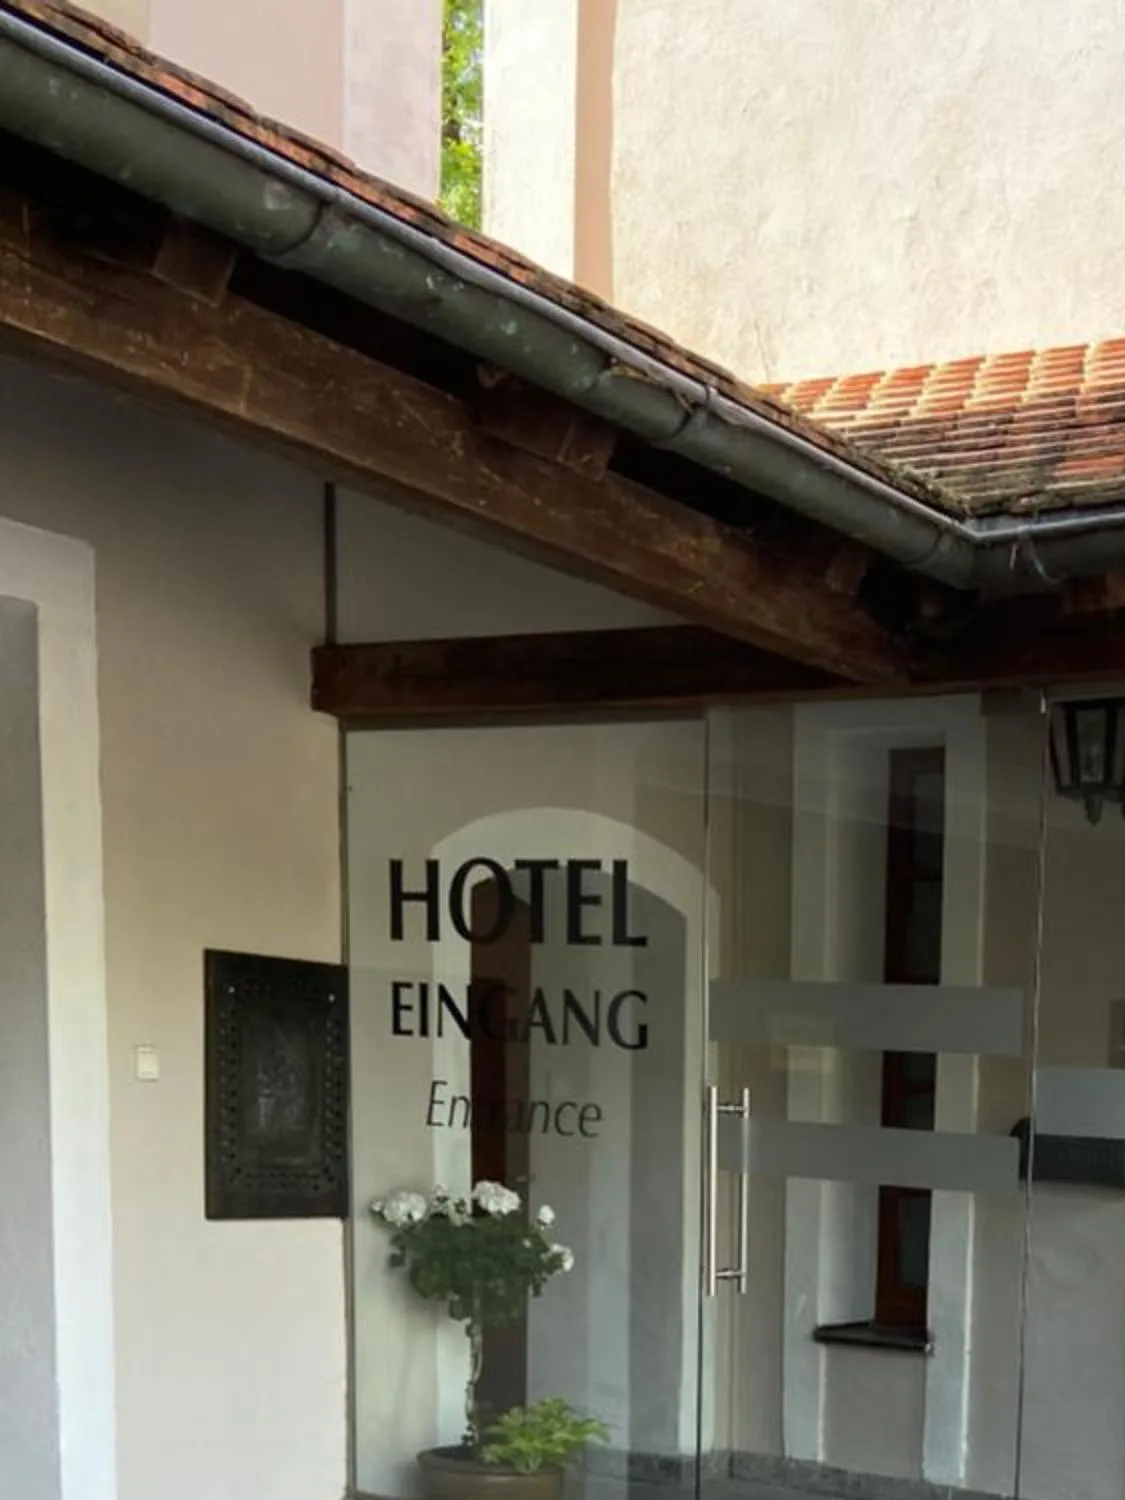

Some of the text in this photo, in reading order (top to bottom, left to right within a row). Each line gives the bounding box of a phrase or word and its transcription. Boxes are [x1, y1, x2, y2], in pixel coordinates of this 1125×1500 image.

[388, 857, 648, 947] HOTEL
[391, 981, 648, 1051] EINGANG
[425, 1080, 603, 1138] Enance
